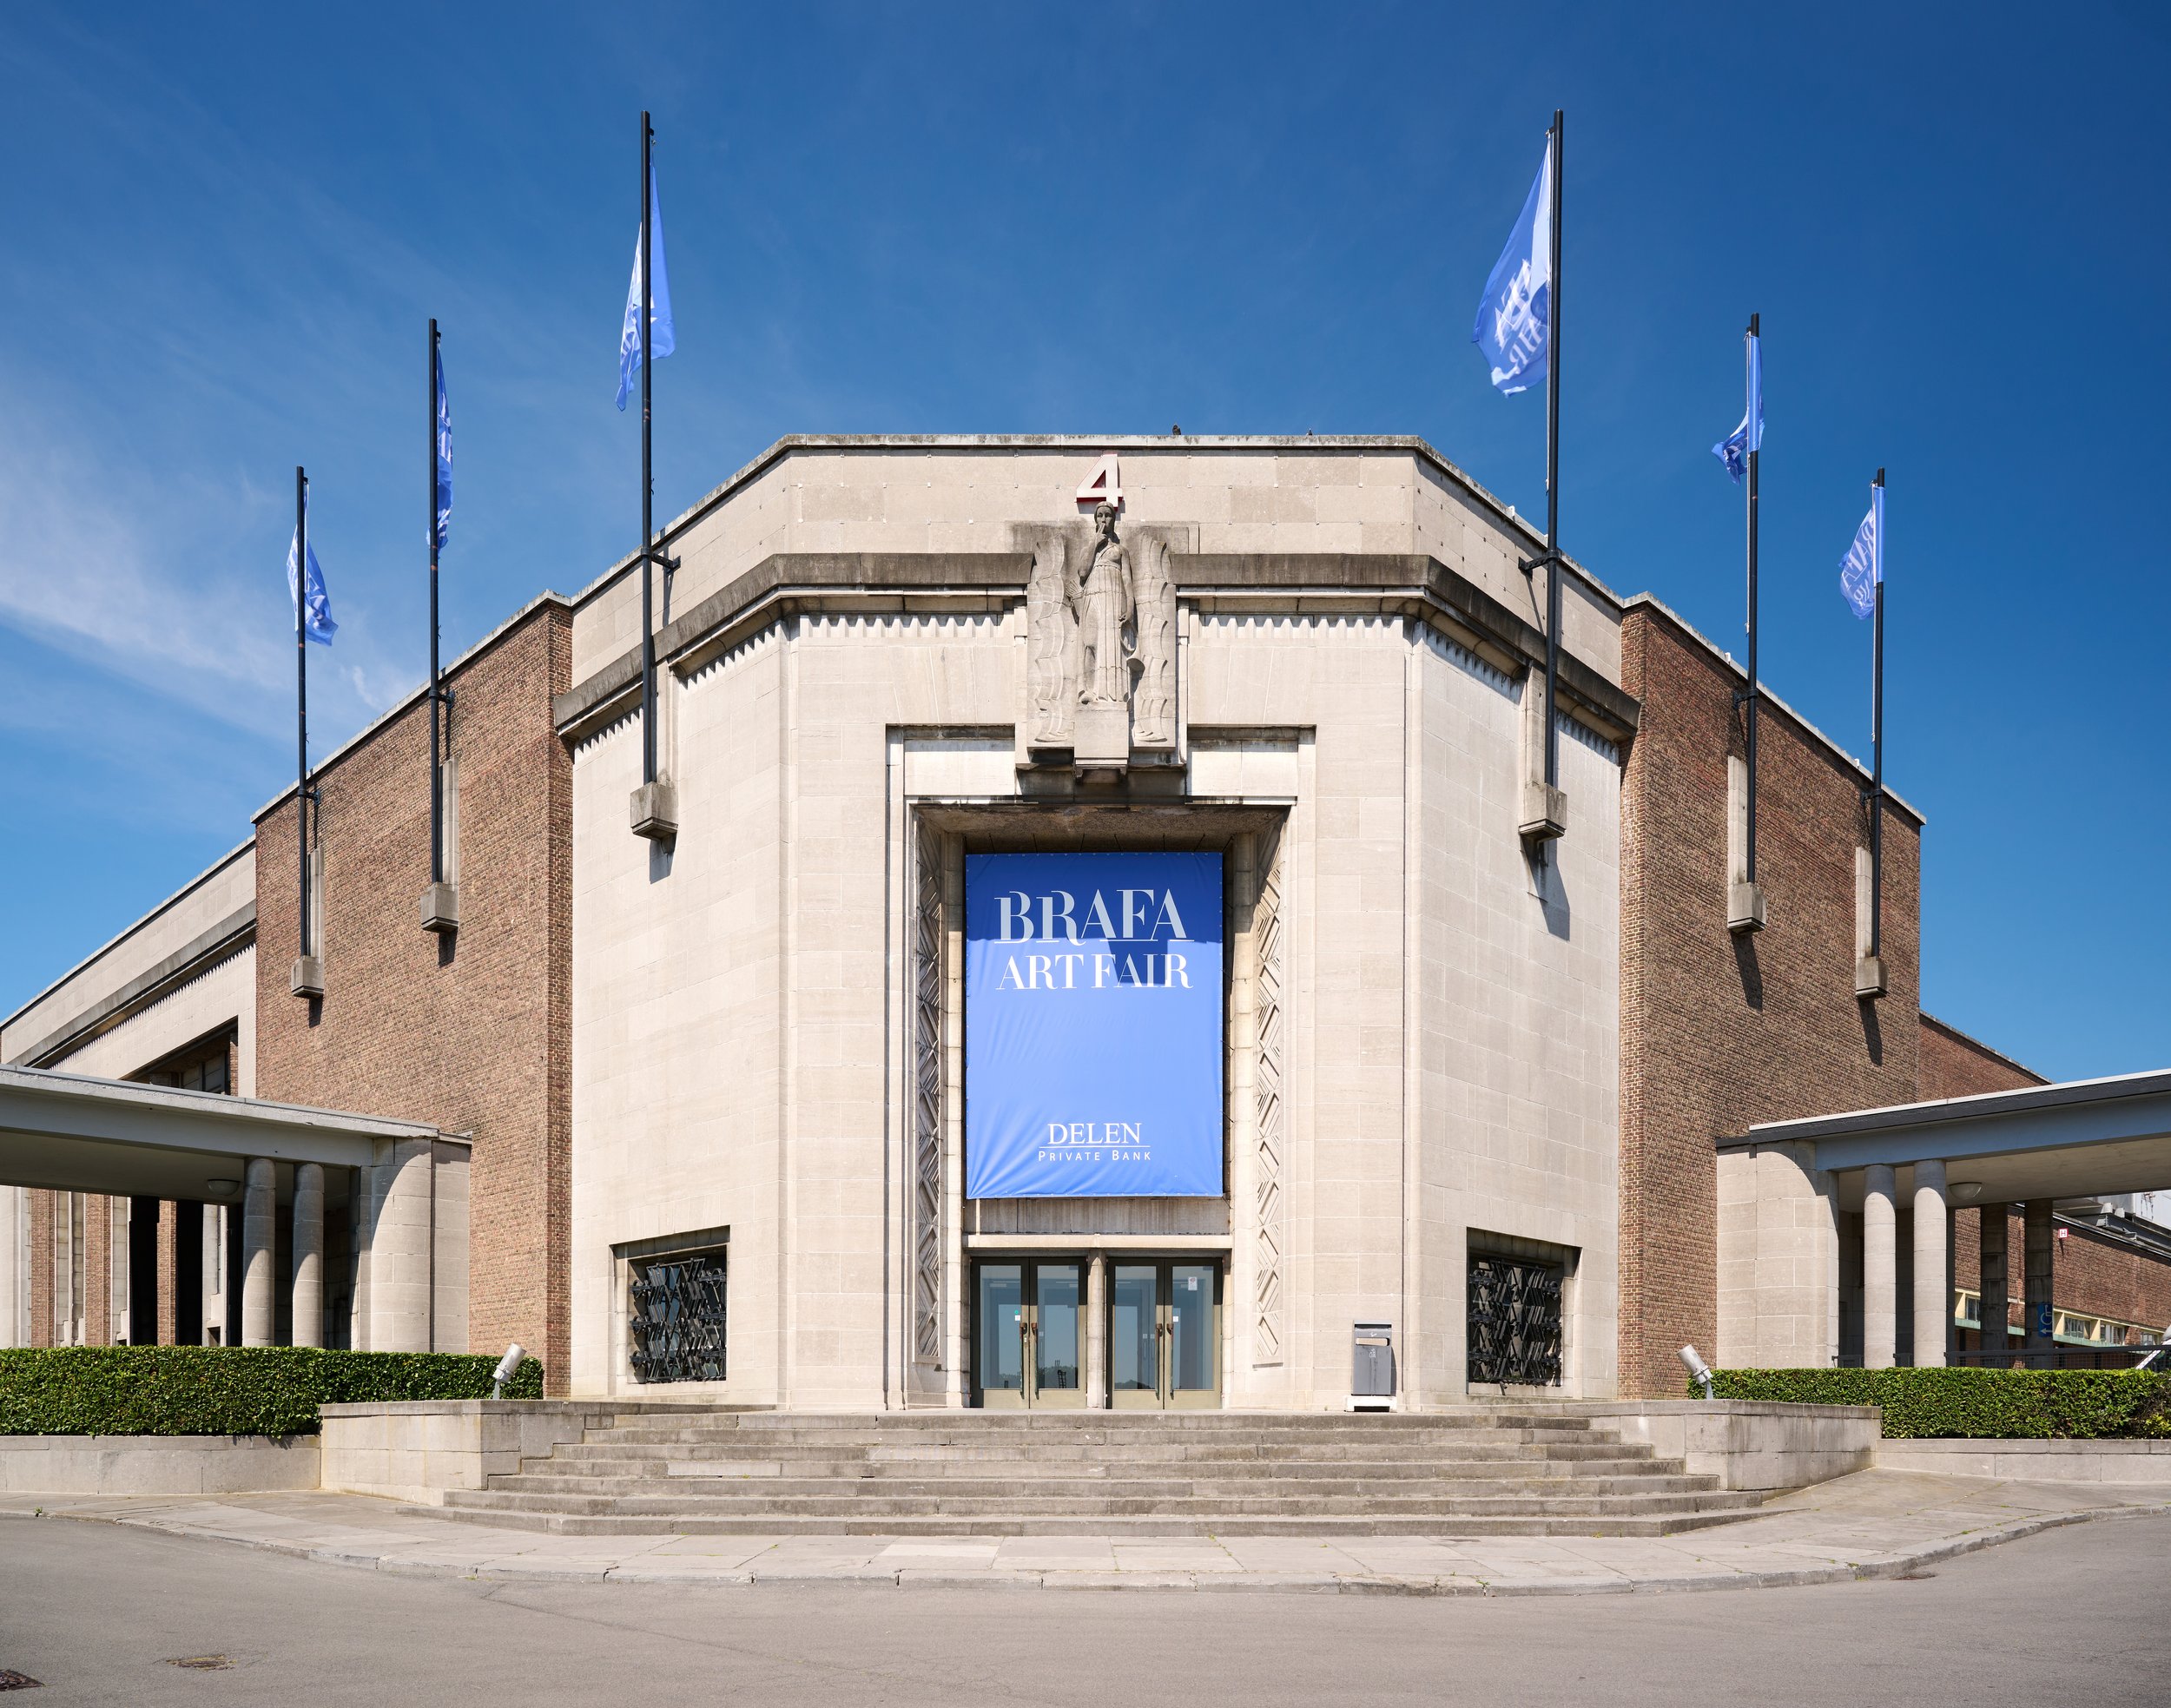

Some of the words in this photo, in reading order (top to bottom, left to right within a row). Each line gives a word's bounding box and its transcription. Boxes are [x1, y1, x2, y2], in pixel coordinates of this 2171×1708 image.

[1076, 453, 1124, 511] 4
[993, 888, 1195, 946] BRAFA
[995, 953, 1085, 990] ART
[1091, 953, 1193, 989] FAIR
[1046, 1123, 1143, 1144] DELEN
